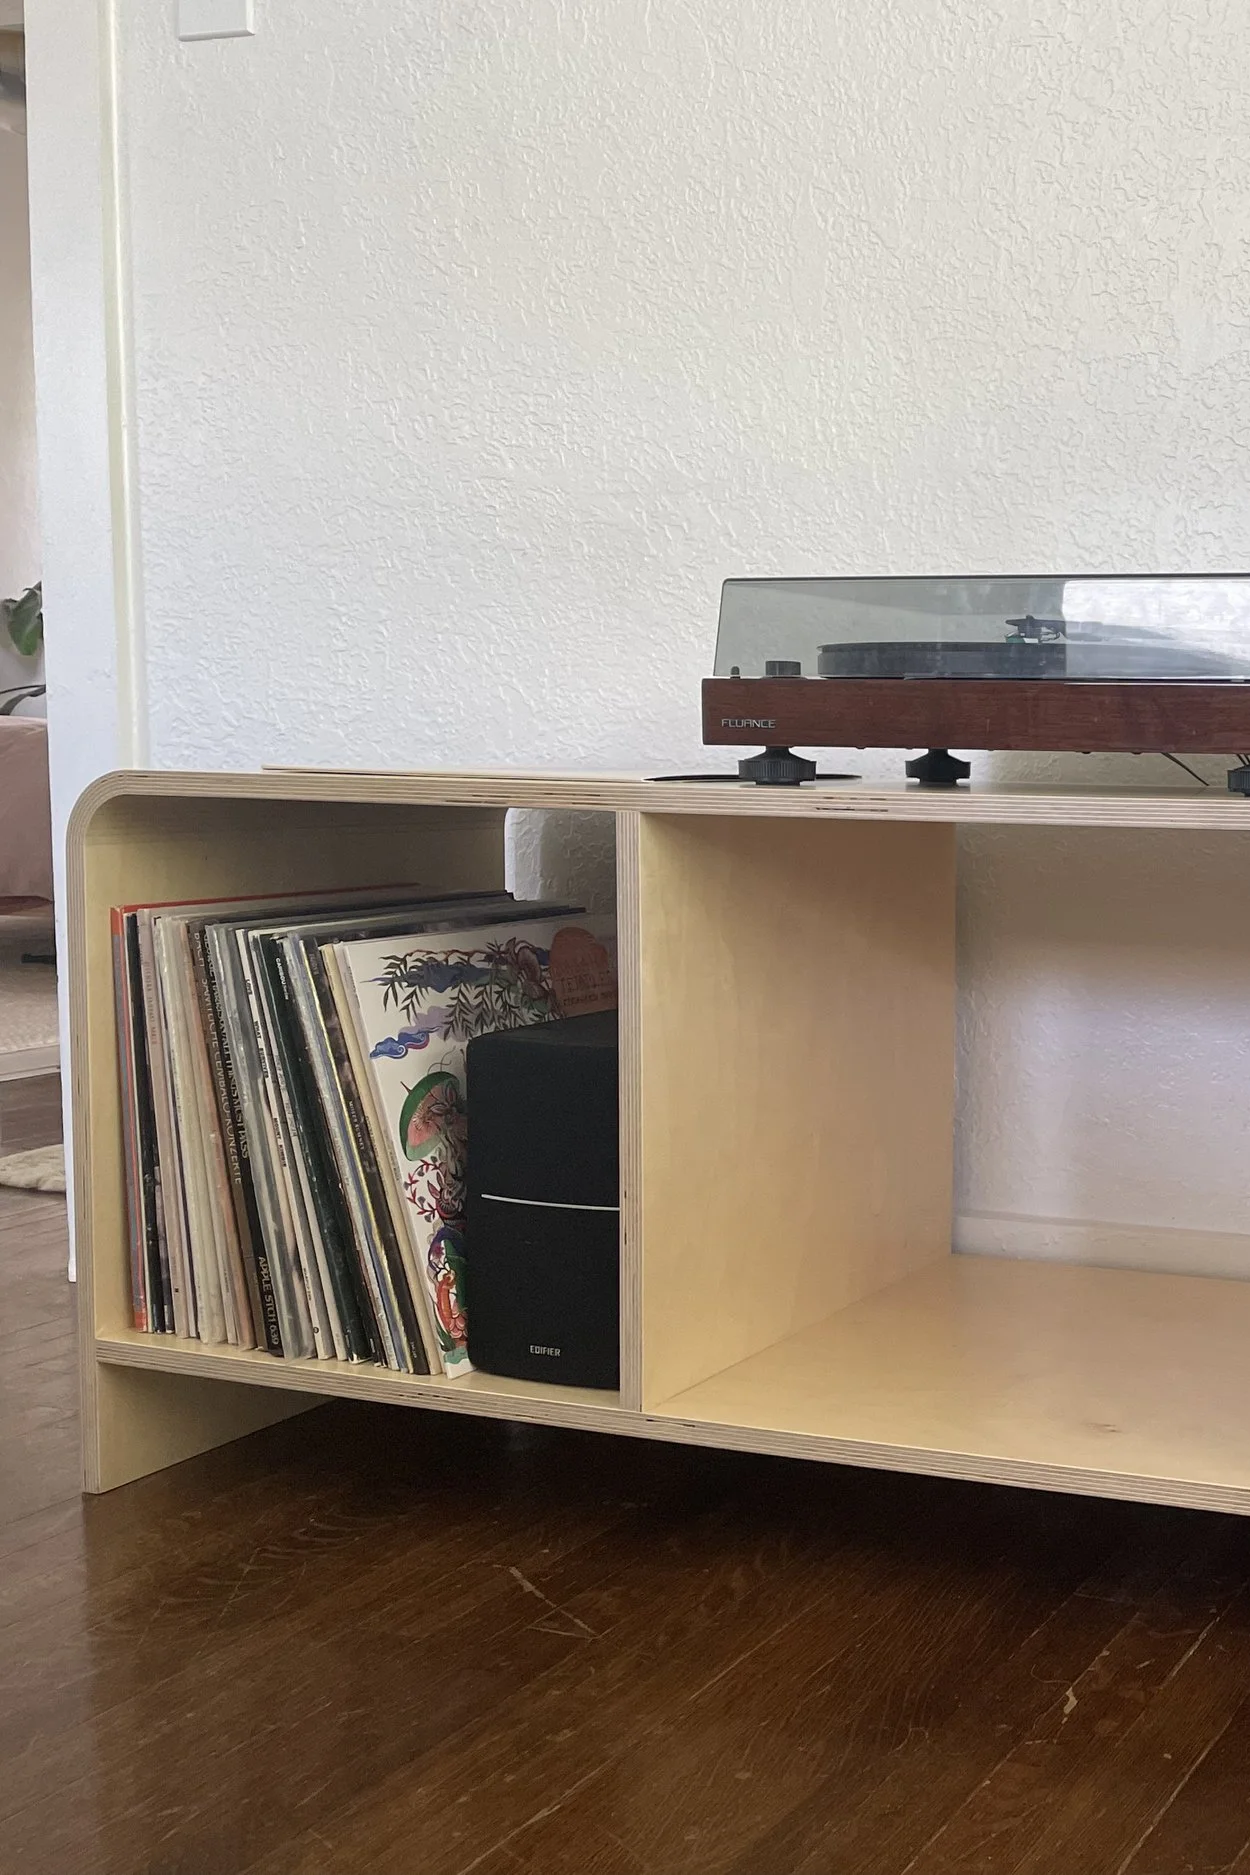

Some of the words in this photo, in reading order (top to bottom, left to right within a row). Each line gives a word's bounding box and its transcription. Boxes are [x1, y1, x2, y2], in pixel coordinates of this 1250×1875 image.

[721, 718, 777, 729] FLUANCE
[274, 957, 286, 984] CARIBOU
[257, 1256, 272, 1292] APPLE
[529, 1345, 561, 1357] EDIFIER
